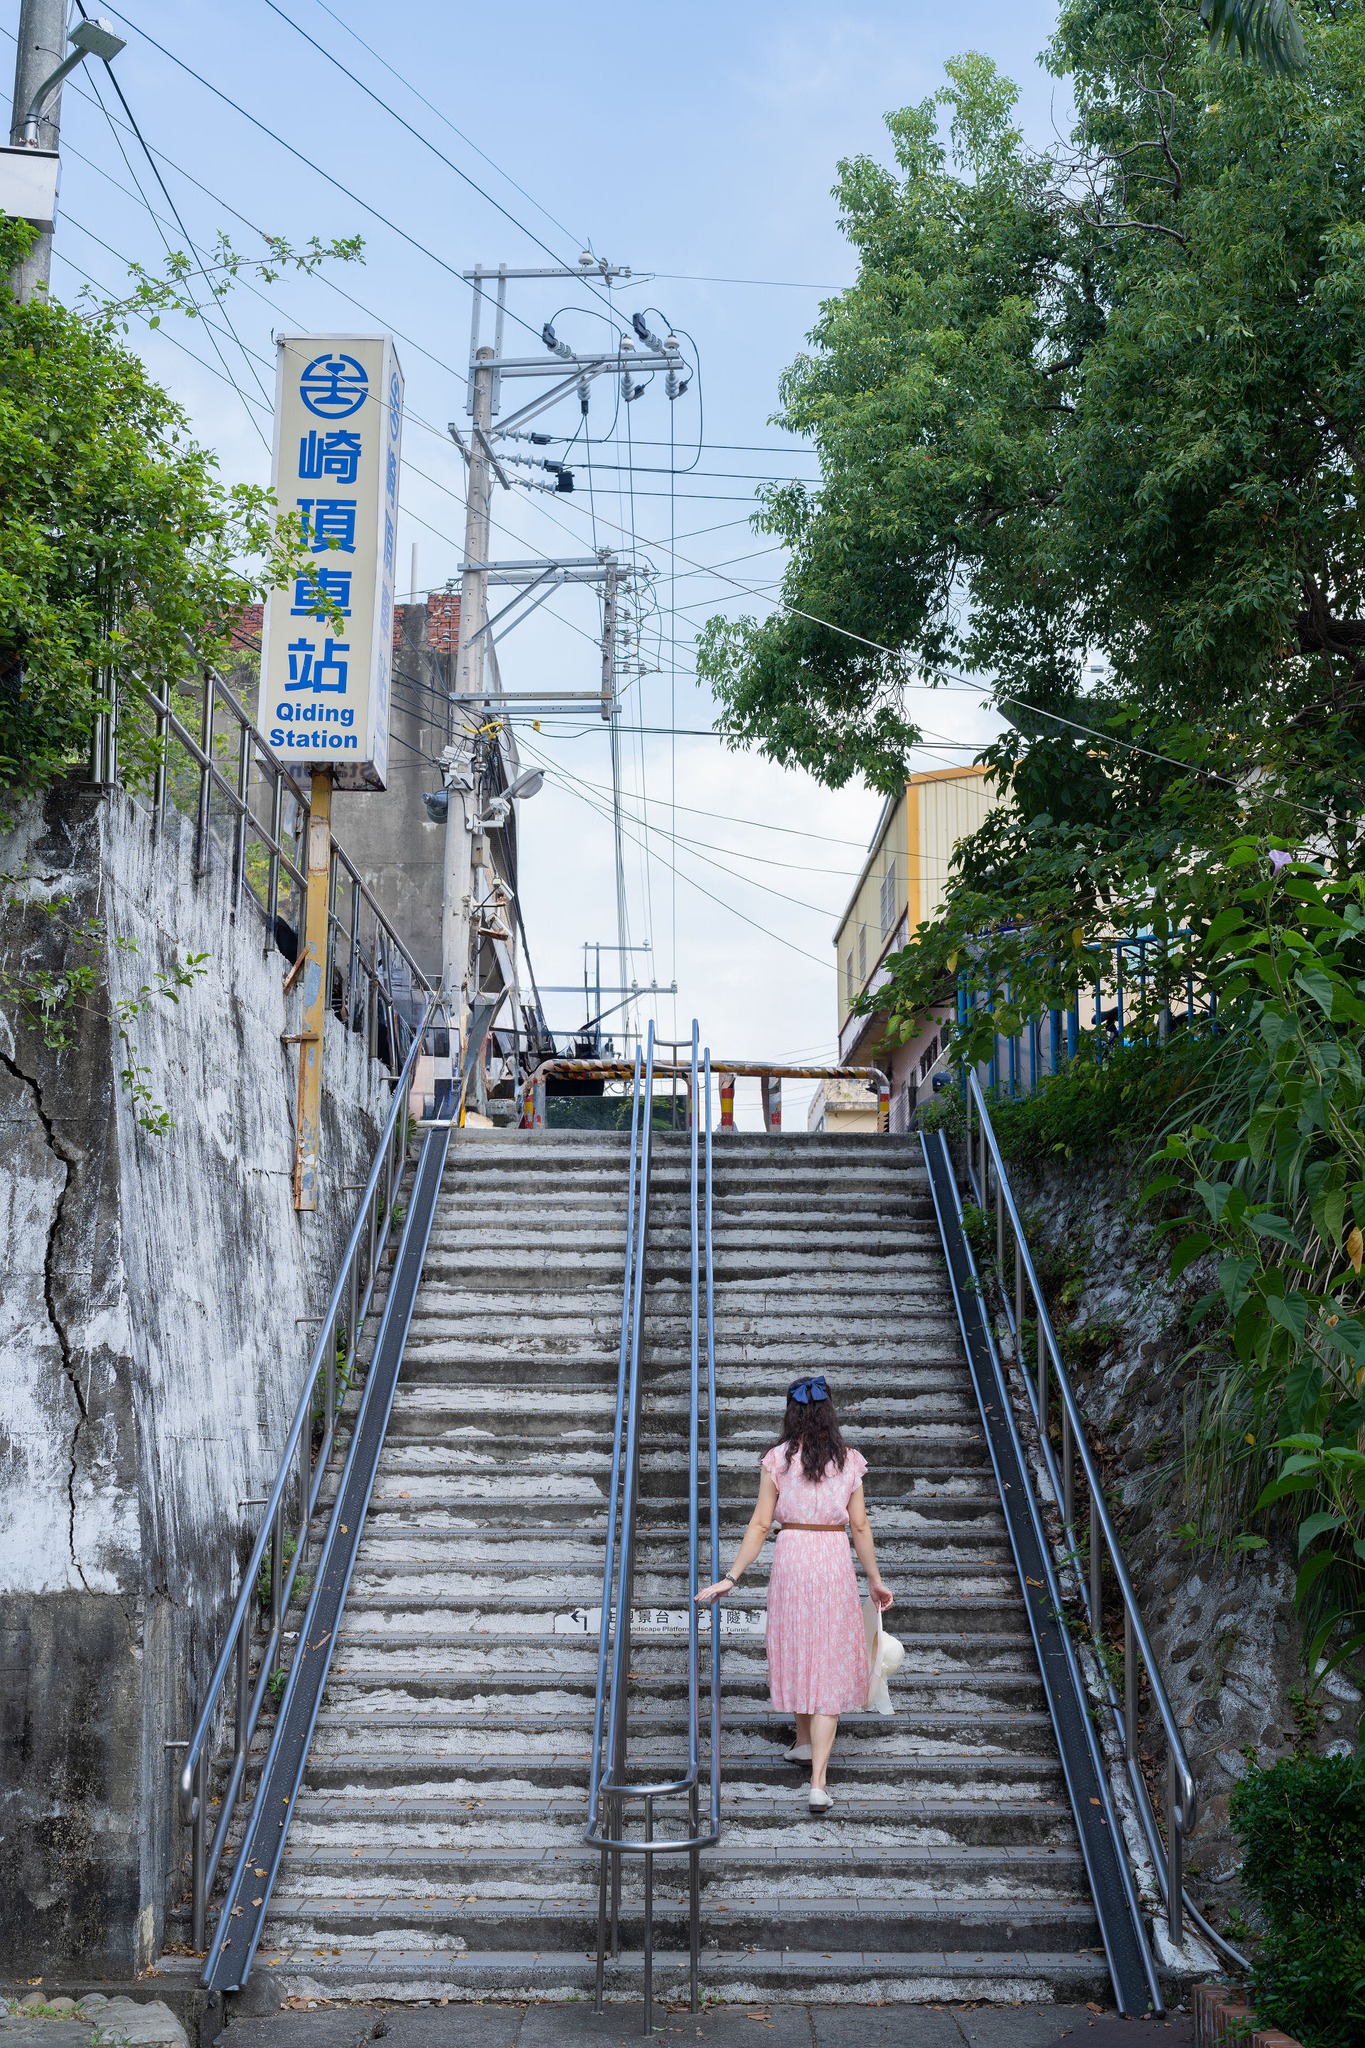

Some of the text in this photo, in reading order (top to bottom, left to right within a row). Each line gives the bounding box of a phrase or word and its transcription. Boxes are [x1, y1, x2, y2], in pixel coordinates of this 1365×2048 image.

[285, 429, 362, 694] 崎頂車站
[276, 702, 355, 727] Qiding
[269, 728, 358, 749] Station
